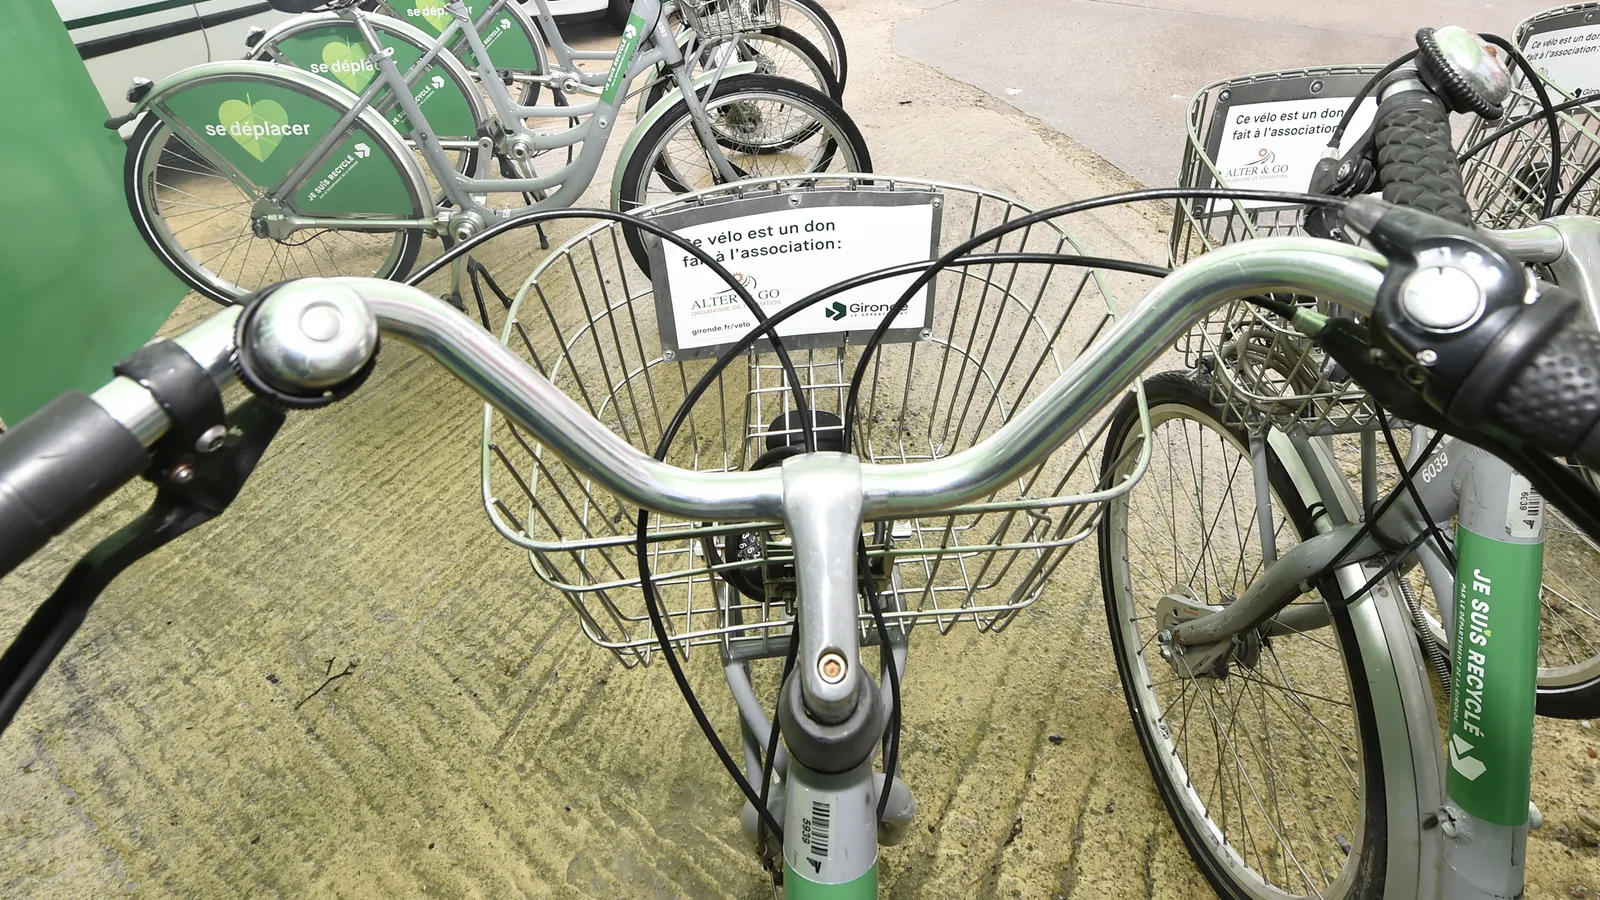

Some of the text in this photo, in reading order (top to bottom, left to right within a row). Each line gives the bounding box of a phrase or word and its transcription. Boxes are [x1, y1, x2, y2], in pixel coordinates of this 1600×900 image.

[407, 5, 473, 19] se dépr
[1531, 41, 1542, 49] Ce
[1543, 37, 1558, 47] vélo
[1559, 36, 1572, 44] est
[1573, 35, 1584, 43] un
[310, 60, 397, 75] se déplac
[414, 84, 431, 104] CYCLÉ
[1583, 86, 1600, 97] Giro
[1236, 108, 1344, 125] Ce vélo est un don
[205, 121, 310, 140] se déplacer
[1232, 130, 1252, 140] fait
[1253, 129, 1261, 138] à
[308, 191, 317, 201] JE
[327, 153, 355, 180] RECYCLÉ
[1224, 164, 1289, 178] ALTER & GO
[707, 231, 742, 246] vélo
[747, 225, 773, 239] est
[779, 224, 799, 236] un
[804, 219, 835, 233] don
[682, 255, 704, 268] fa
[716, 250, 725, 262] à
[691, 293, 738, 310] ALTER
[757, 288, 780, 300] GO
[691, 306, 731, 317] ORGANISME
[691, 321, 751, 336] gironde.fr/velo
[1422, 452, 1449, 483] 6039
[1473, 568, 1492, 596] JE
[1460, 599, 1466, 610] LE
[1457, 610, 1466, 666] DÉPARTEMENT
[1456, 666, 1462, 677] DE
[1455, 677, 1461, 688] LA
[1463, 648, 1486, 738] RECYCLÉ
[1453, 689, 1461, 723] GIRONDE
[801, 817, 812, 845] 5939
